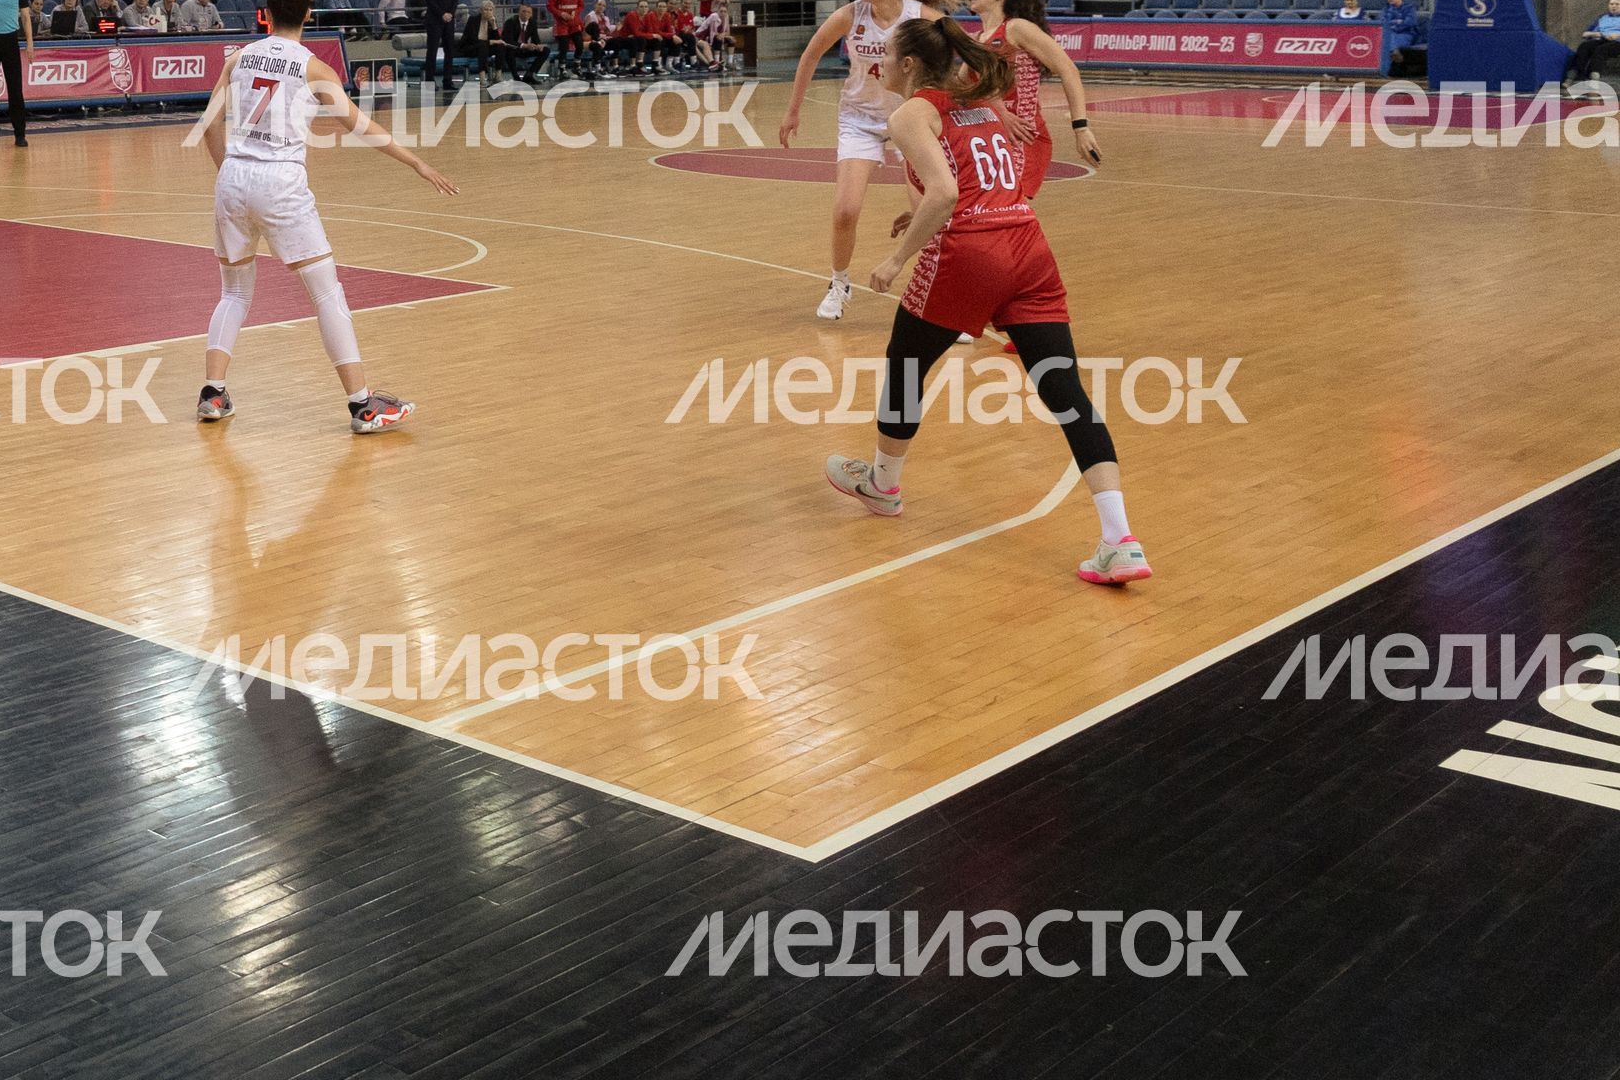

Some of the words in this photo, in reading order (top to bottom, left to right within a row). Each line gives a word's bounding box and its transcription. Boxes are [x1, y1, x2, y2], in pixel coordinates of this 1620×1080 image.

[1093, 34, 1176, 51] ПРЕМЬЕР-ЛИГА
[1278, 39, 1334, 54] PARI
[31, 63, 84, 83] PARI
[155, 58, 203, 77] PARI
[239, 54, 287, 75] КУЗНЕЦОВА
[288, 61, 303, 79] АН.
[248, 76, 281, 125] 7
[969, 133, 1016, 191] 66
